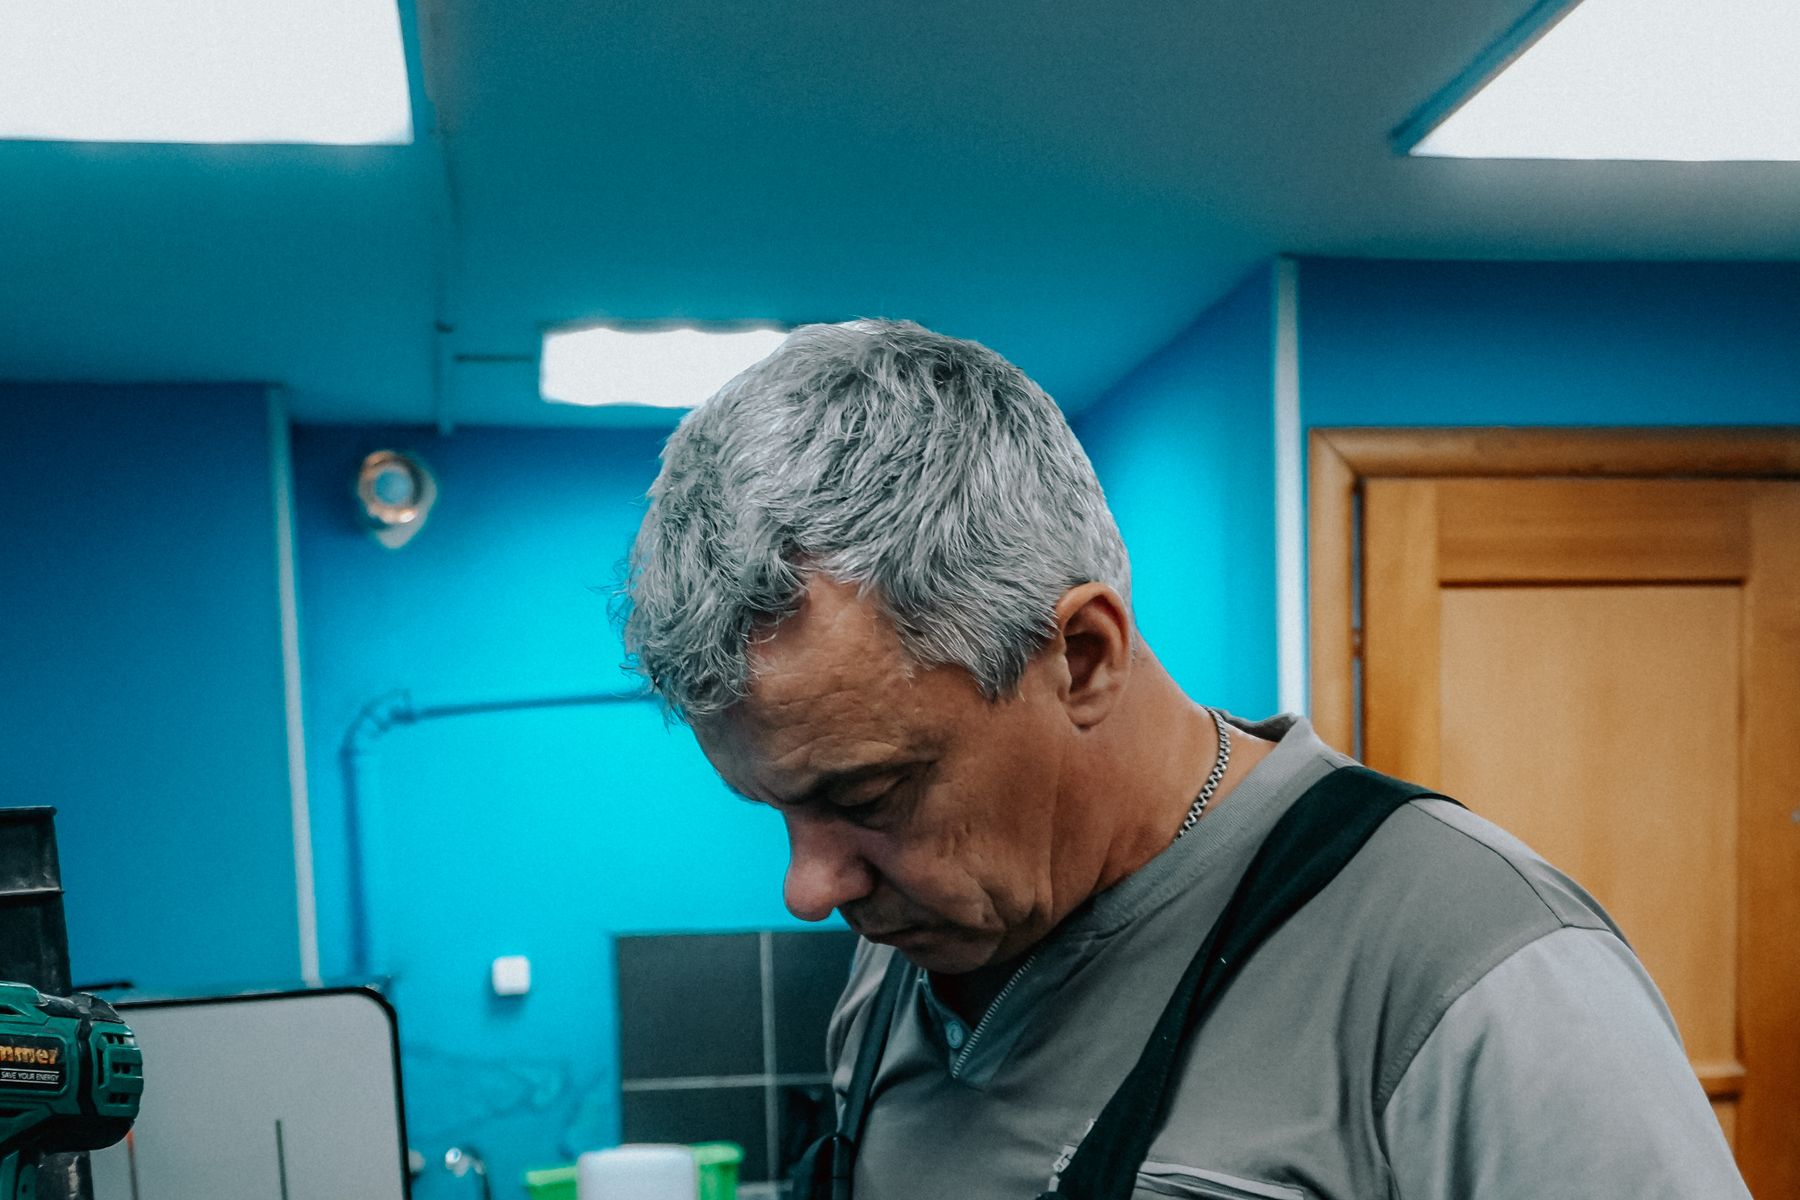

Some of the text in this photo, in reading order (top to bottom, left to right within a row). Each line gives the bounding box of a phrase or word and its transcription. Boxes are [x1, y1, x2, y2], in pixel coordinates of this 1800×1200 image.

[1, 1071, 59, 1081] SAVE YOUR ENERGY
